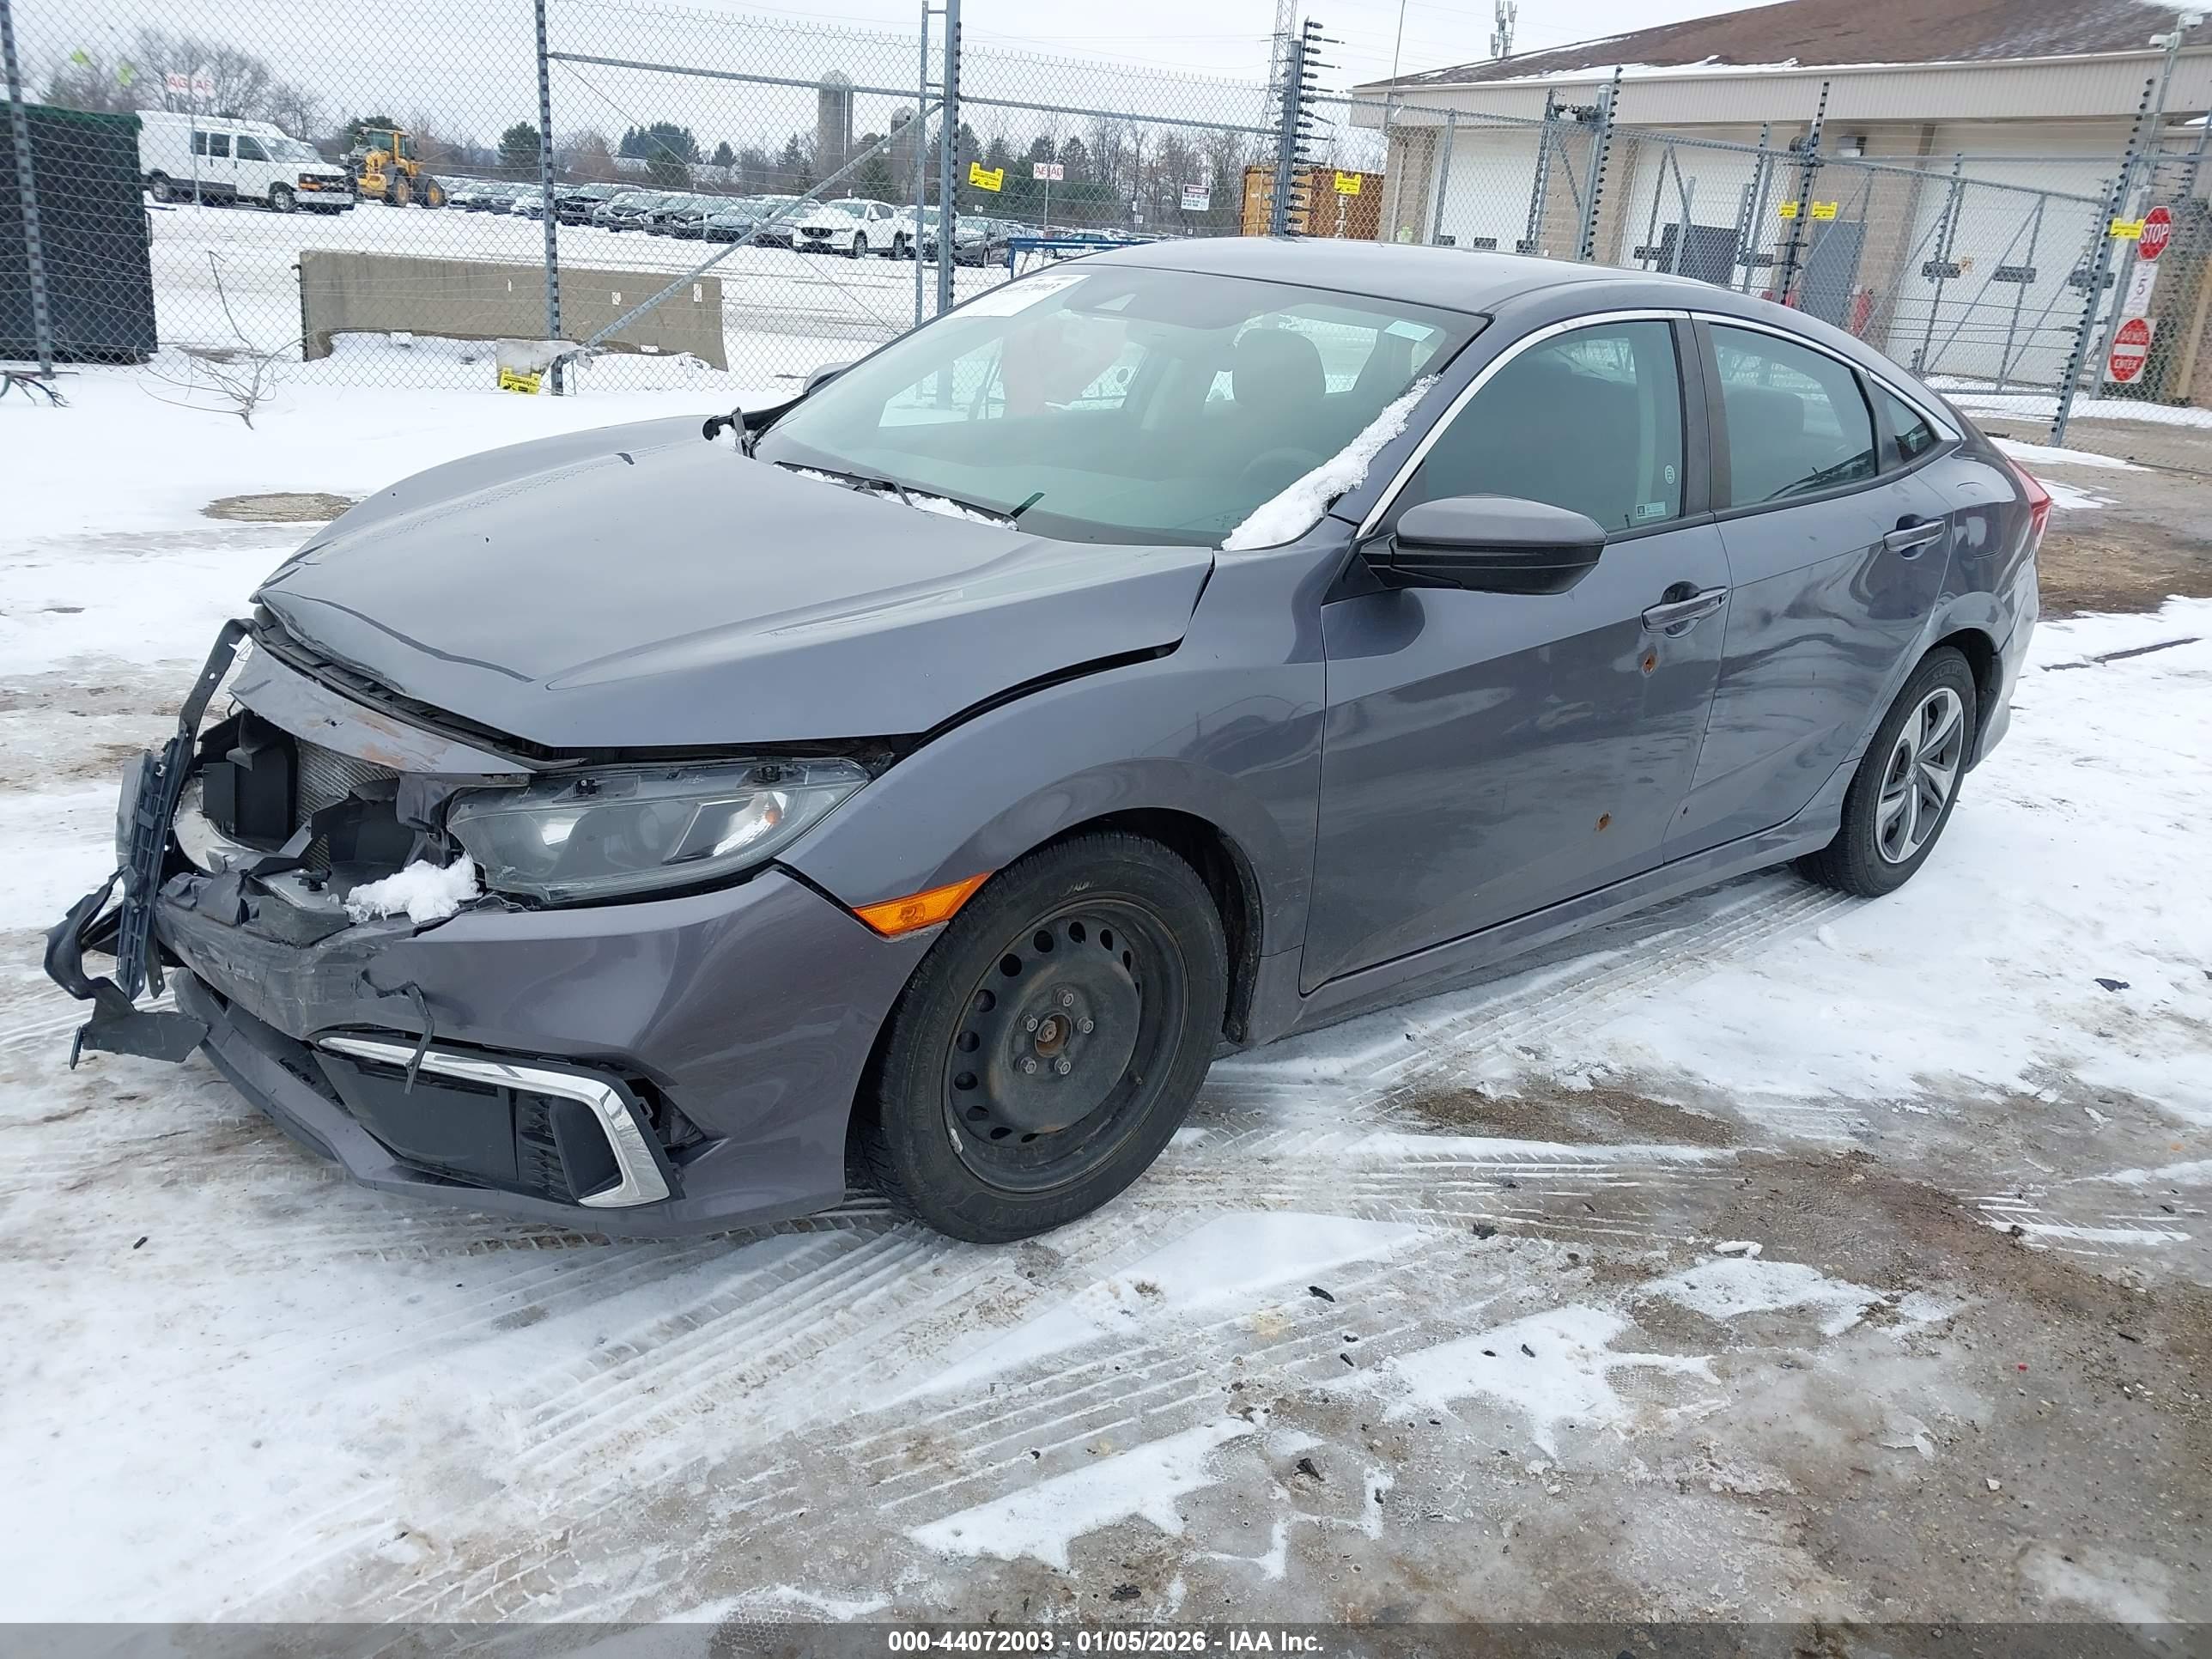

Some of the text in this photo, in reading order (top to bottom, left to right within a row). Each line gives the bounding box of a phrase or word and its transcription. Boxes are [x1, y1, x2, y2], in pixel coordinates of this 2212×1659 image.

[2140, 223, 2169, 244] STOP
[2136, 277, 2148, 295] 5
[2115, 359, 2137, 370] ENTER
